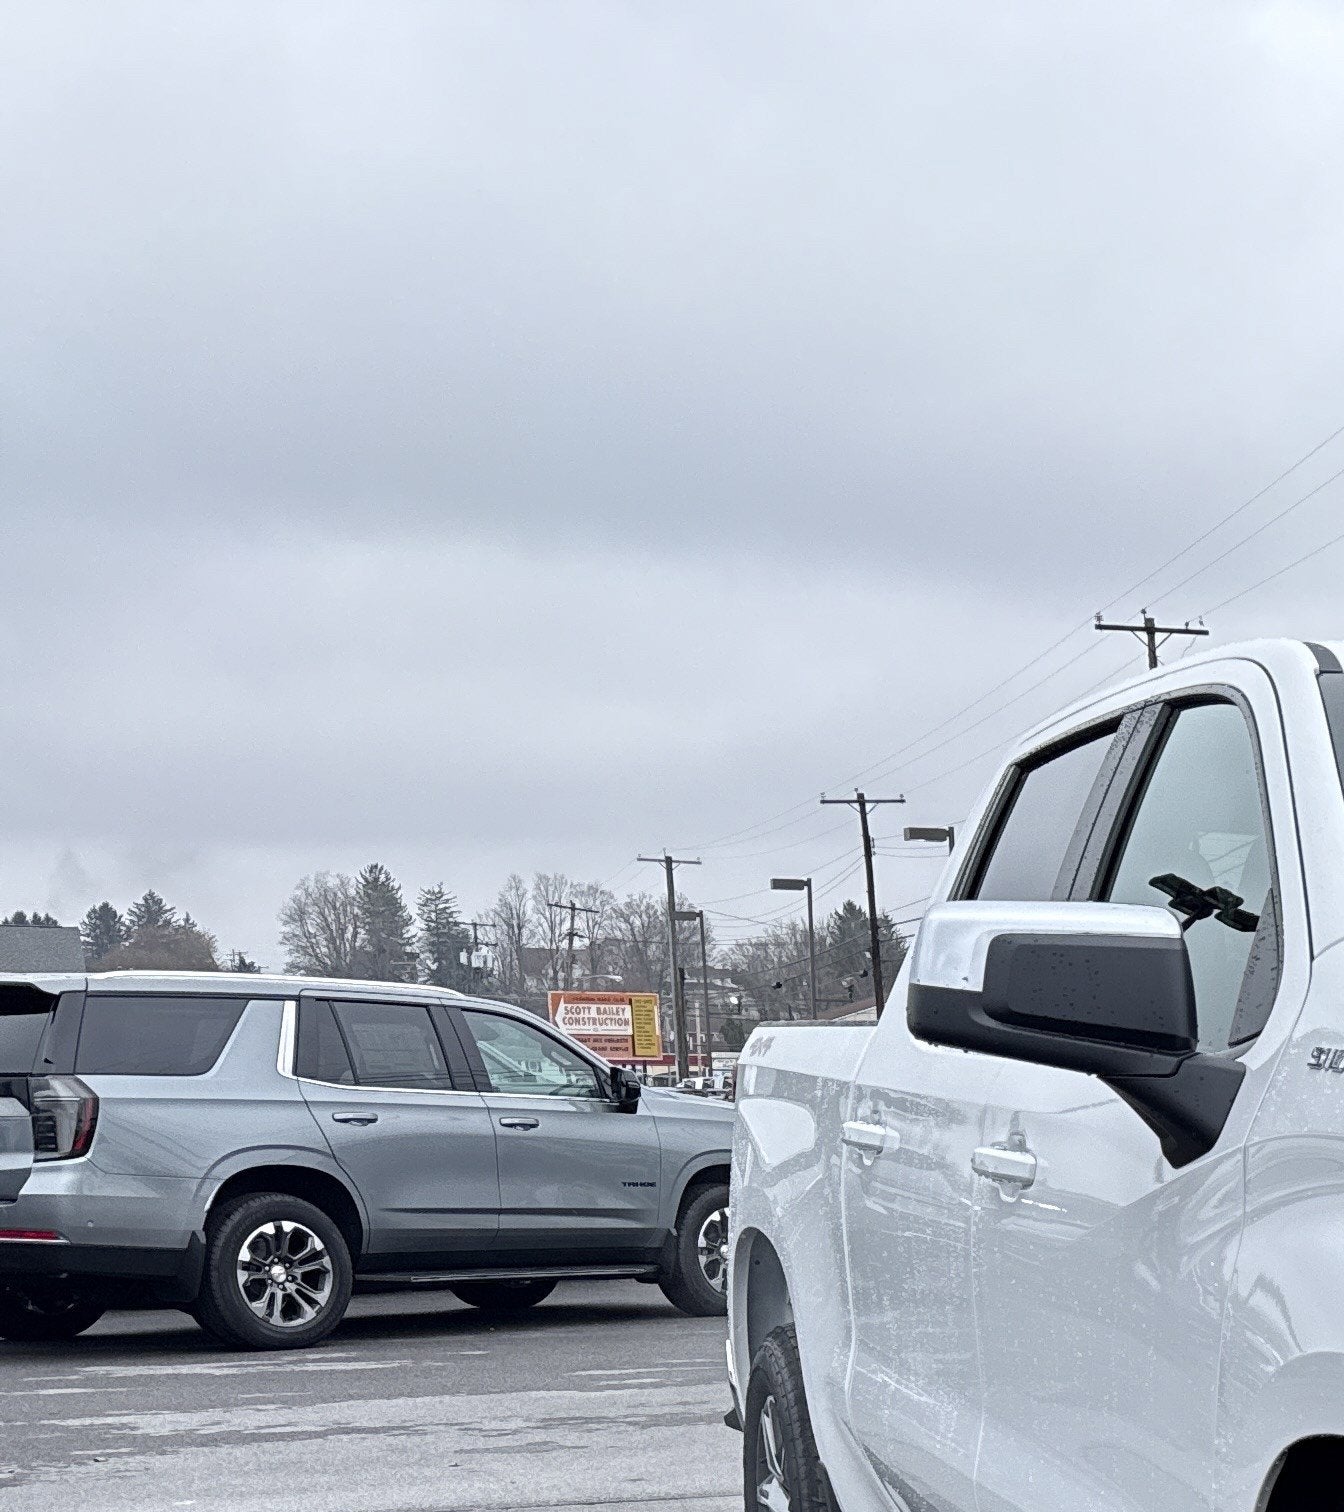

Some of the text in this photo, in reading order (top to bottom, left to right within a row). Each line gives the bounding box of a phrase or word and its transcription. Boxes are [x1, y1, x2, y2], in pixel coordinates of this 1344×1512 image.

[563, 1005, 626, 1016] SCOTT BAILEY
[562, 1016, 630, 1027] CONSTRUCTION
